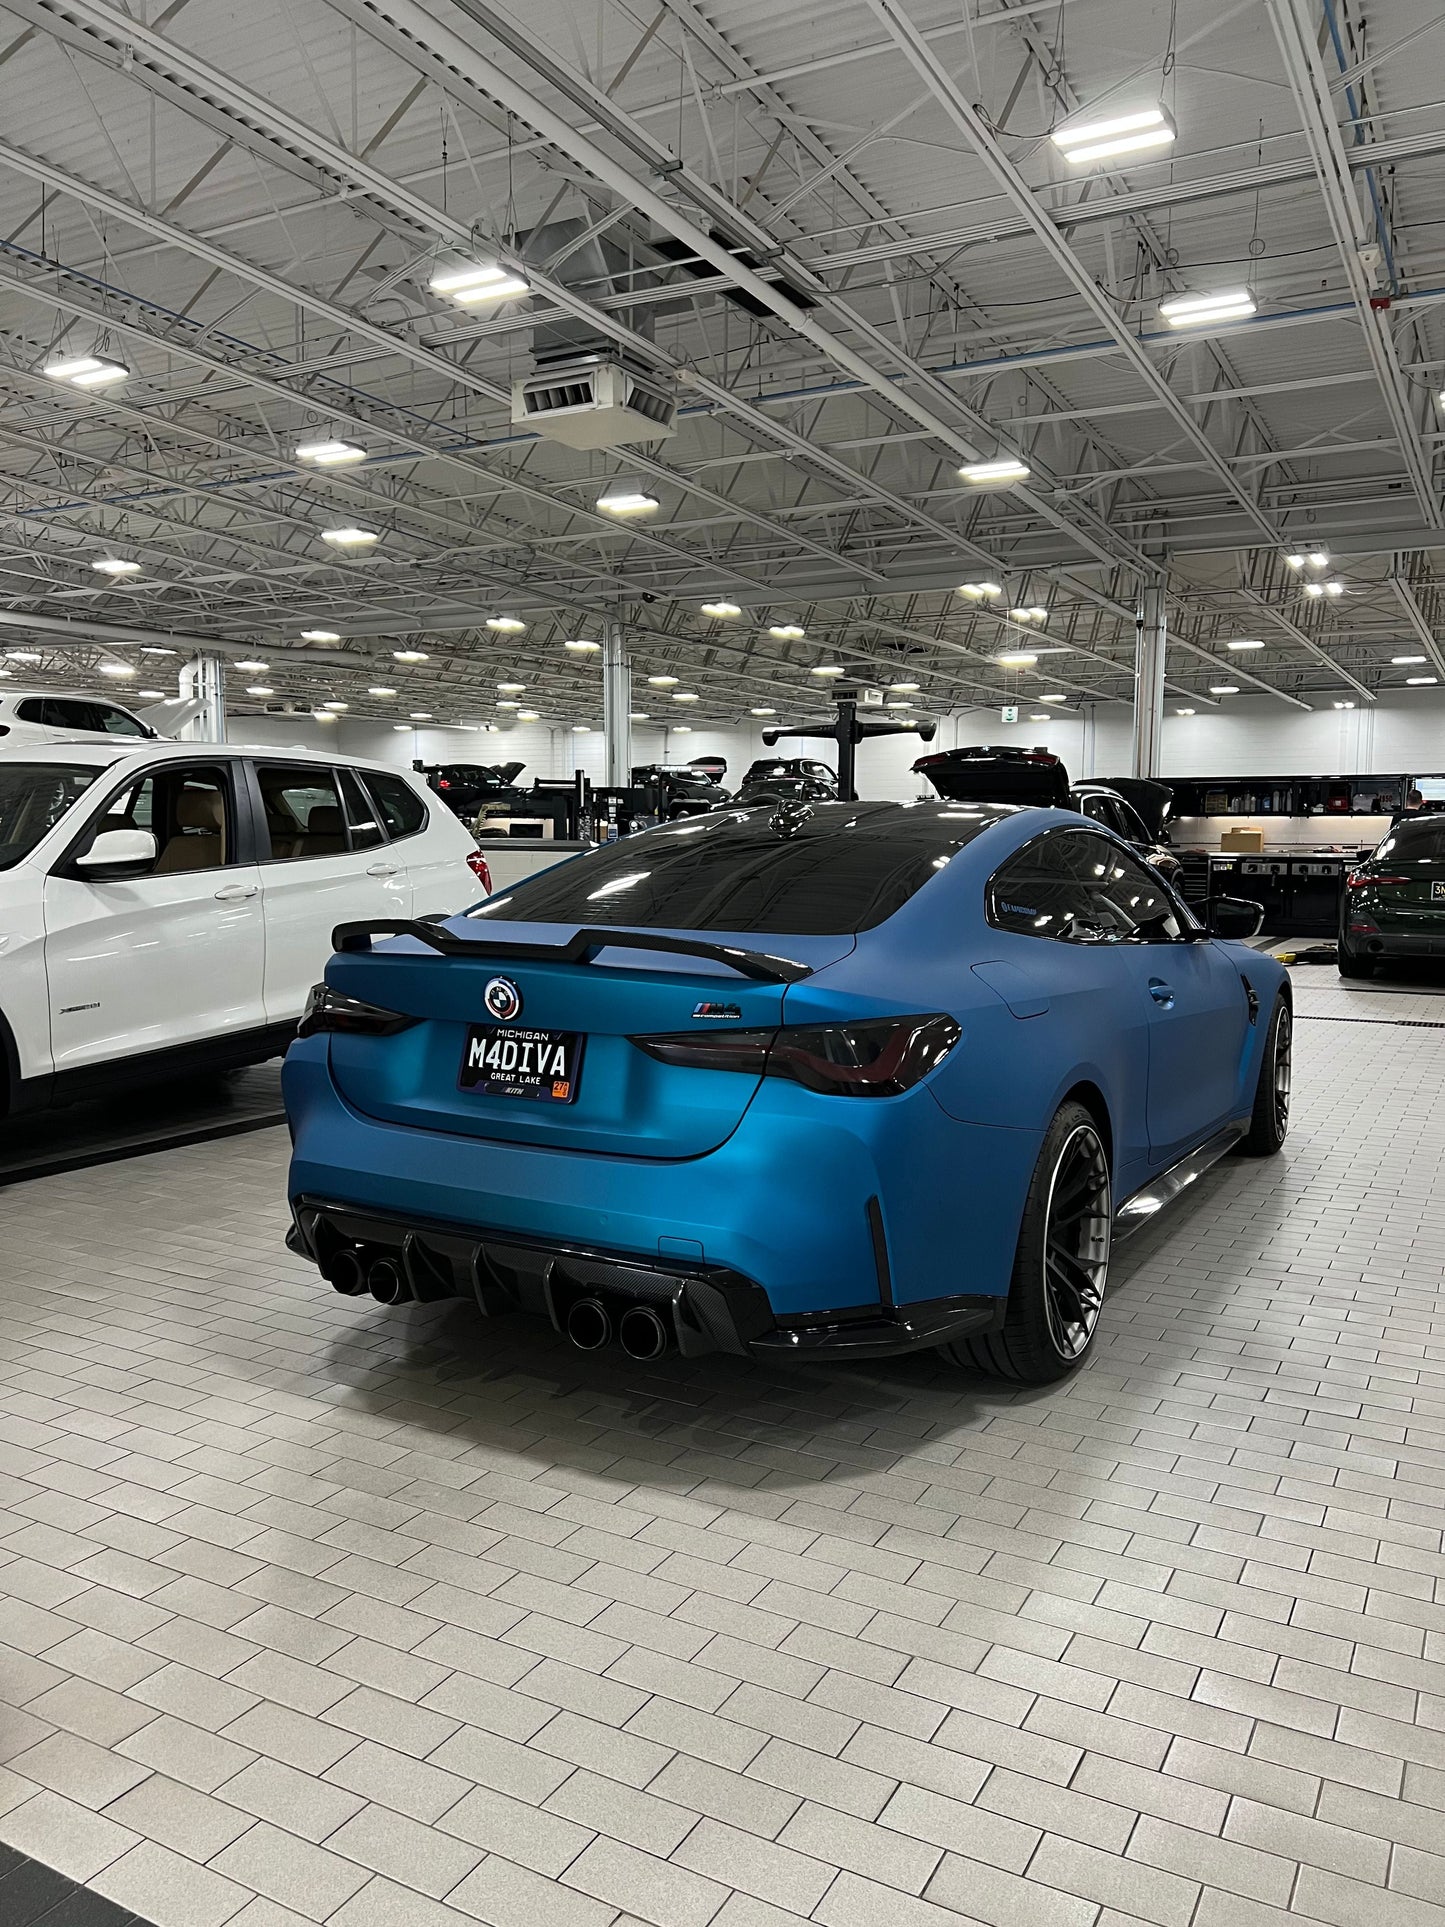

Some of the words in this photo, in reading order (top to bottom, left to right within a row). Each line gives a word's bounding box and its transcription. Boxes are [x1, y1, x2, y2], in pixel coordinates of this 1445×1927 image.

[497, 1029, 549, 1041] MICHIGAN
[468, 1037, 565, 1077] M4DIVA
[490, 1072, 516, 1082] GREAT
[519, 1075, 541, 1085] LAKE
